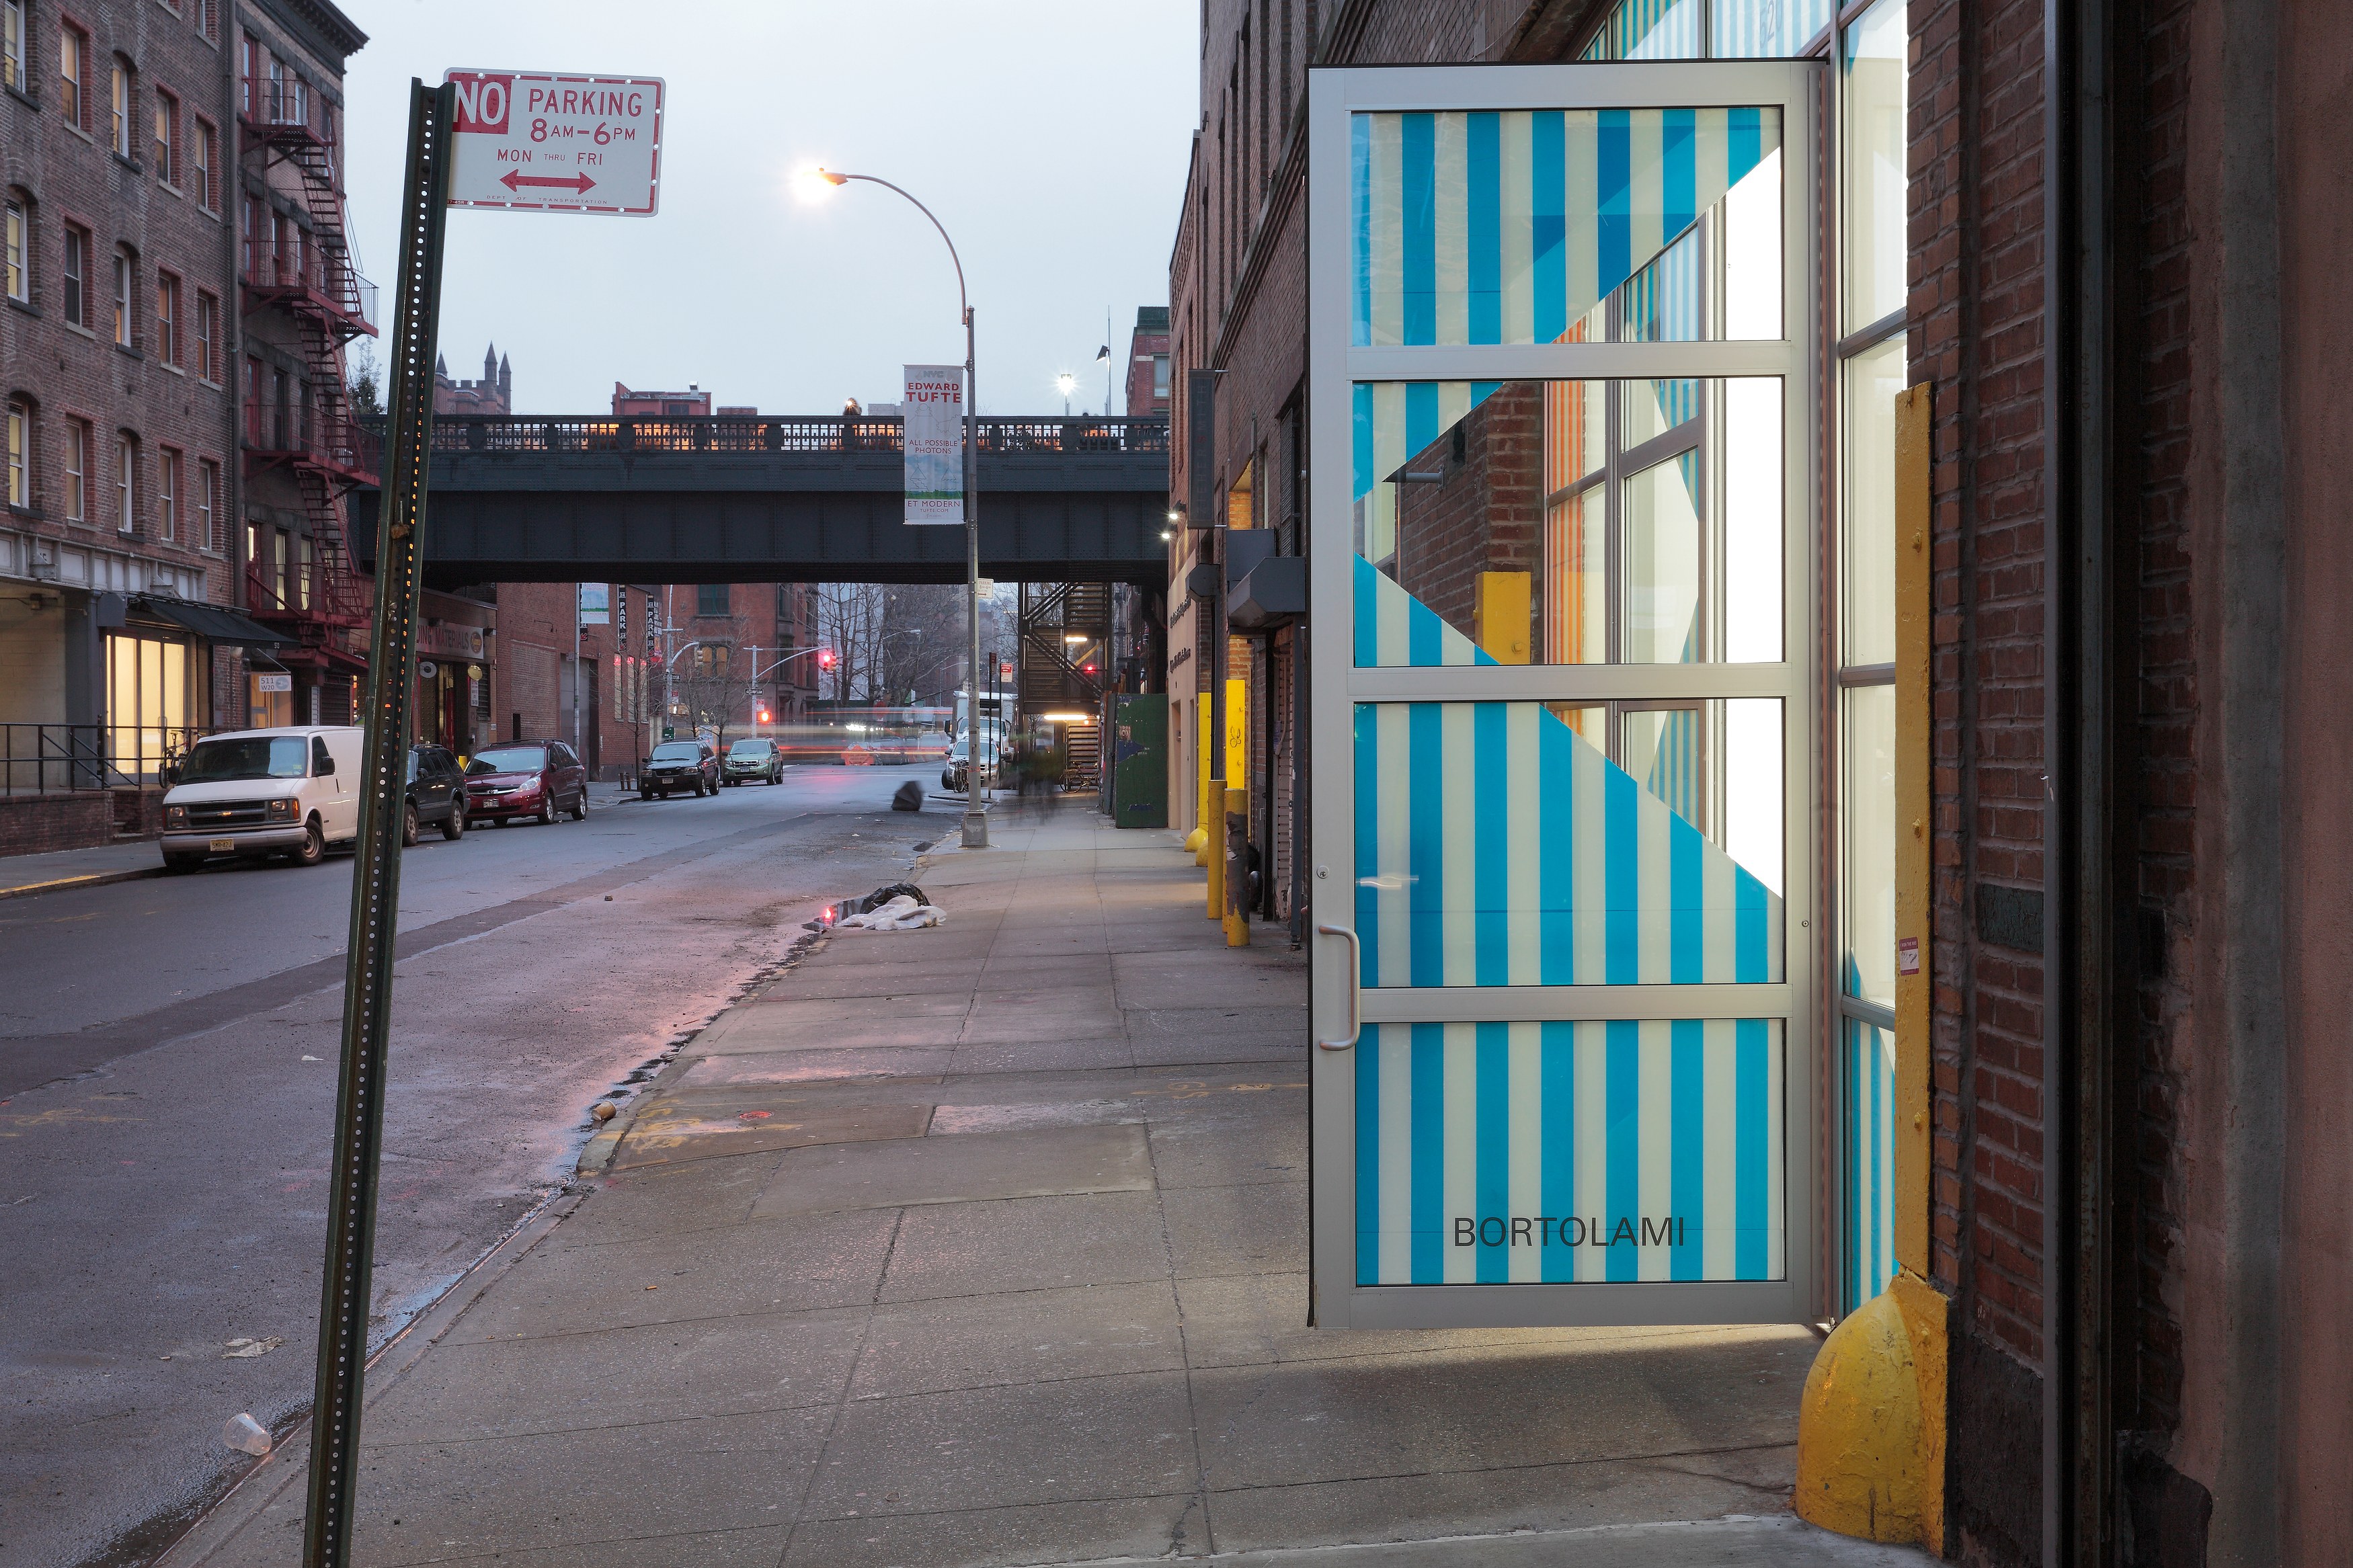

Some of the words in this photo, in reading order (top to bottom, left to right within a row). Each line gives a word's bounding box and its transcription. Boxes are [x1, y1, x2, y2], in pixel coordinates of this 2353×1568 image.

[453, 80, 507, 125] NO
[528, 88, 643, 117] PARKING
[497, 149, 532, 163] MON
[544, 153, 565, 161] THRU
[577, 152, 602, 165] FRI
[908, 382, 959, 391] EDWARD
[906, 392, 961, 403] TUFTE
[436, 627, 469, 651] MATERIALS
[1454, 1216, 1685, 1247] BORTOLAMI
